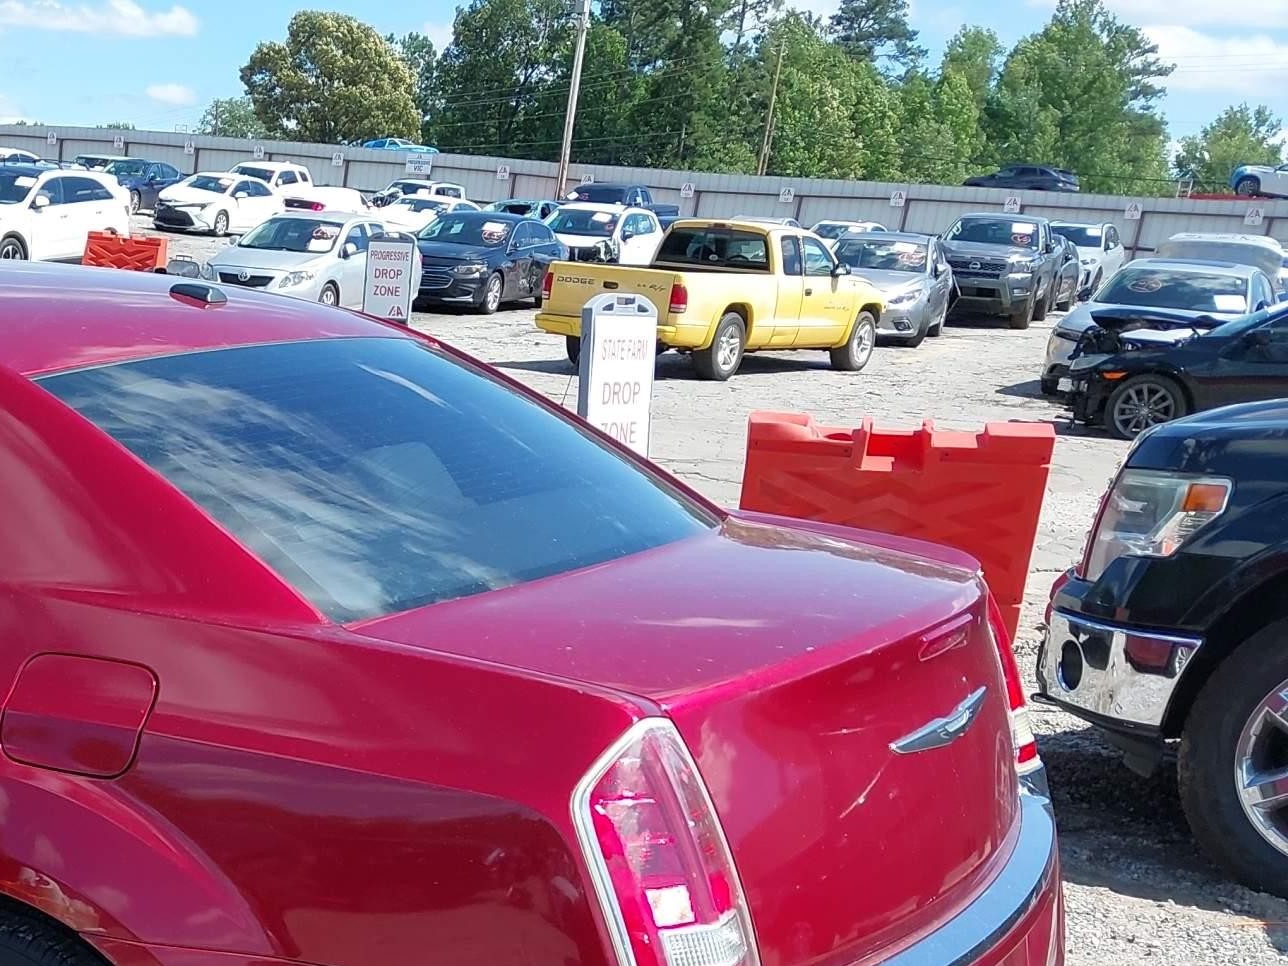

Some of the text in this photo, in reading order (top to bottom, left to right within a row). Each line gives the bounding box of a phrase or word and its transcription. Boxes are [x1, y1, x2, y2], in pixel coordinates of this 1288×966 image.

[370, 249, 410, 262] PROGRESSIVE
[374, 268, 403, 280] DROP
[556, 275, 595, 285] DODGE
[373, 285, 401, 297] ZONE
[601, 338, 649, 361] STATE FARM
[602, 381, 641, 406] DROP
